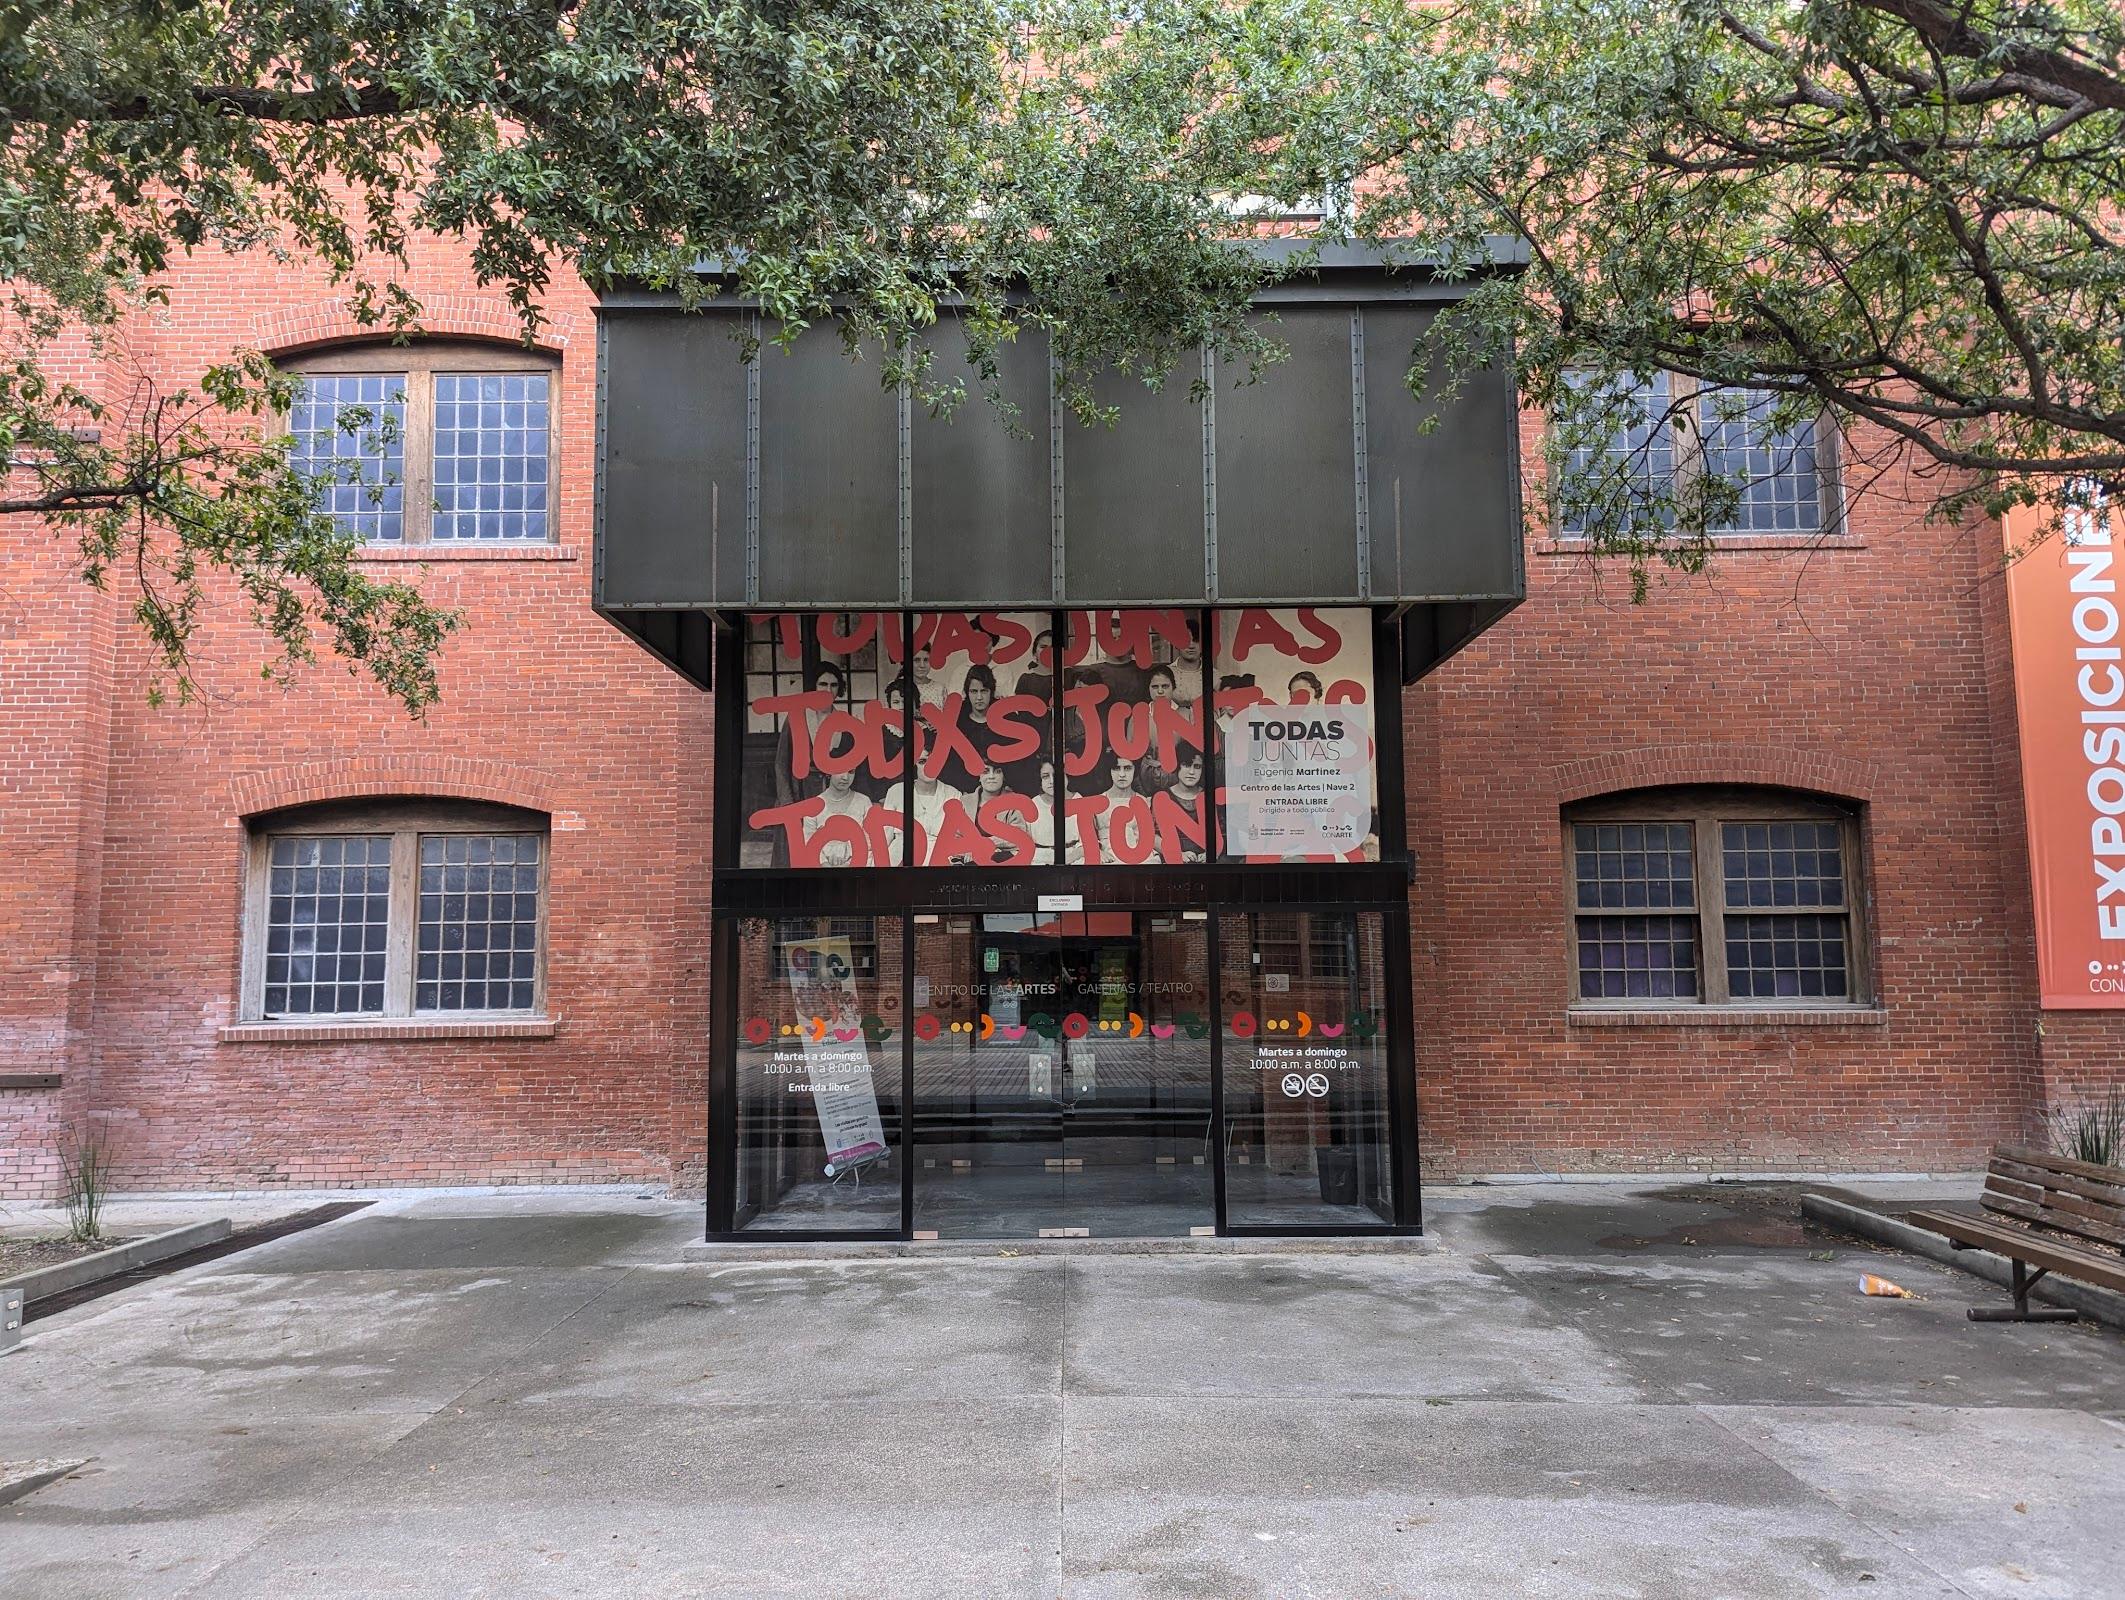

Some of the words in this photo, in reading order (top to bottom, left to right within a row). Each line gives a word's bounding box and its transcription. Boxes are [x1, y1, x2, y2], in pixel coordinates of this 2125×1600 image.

[1248, 721, 1345, 741] TODAS
[1252, 740, 1341, 762] JUNTAS
[1254, 768, 1293, 778] Eugenia
[1240, 784, 1270, 792] Centro
[1271, 783, 1282, 792] de
[1283, 783, 1296, 791] las
[1297, 783, 1321, 791] Artes
[1326, 783, 1348, 791] Nave
[1349, 783, 1355, 791] 2
[1265, 798, 1304, 806] ENTRADA
[1259, 806, 1286, 814] Dirigido
[749, 793, 1039, 868] TODAS
[919, 984, 968, 996] CENTRO
[970, 984, 987, 995] DE
[989, 983, 1013, 995] LAS
[1015, 983, 1056, 995] ARTES
[1147, 982, 1193, 994] TEATRO
[2089, 978, 2125, 993] CON
[774, 1052, 809, 1061] Martes
[820, 1052, 863, 1062] domingo
[1258, 1047, 1294, 1057] Martes
[1296, 1049, 1302, 1057] a
[1305, 1047, 1348, 1057] domingo
[763, 1064, 793, 1074] 10:00
[795, 1065, 816, 1074] a.m.
[828, 1063, 851, 1073] 8:00
[853, 1064, 875, 1075] p.m.
[1249, 1060, 1278, 1070] 10:00
[1280, 1061, 1302, 1069] a.m.
[1305, 1061, 1311, 1069] a
[1314, 1059, 1337, 1069] 8:00
[1339, 1060, 1361, 1071] p.m.
[788, 1083, 826, 1092] Entrada
[829, 1083, 850, 1092] libre
